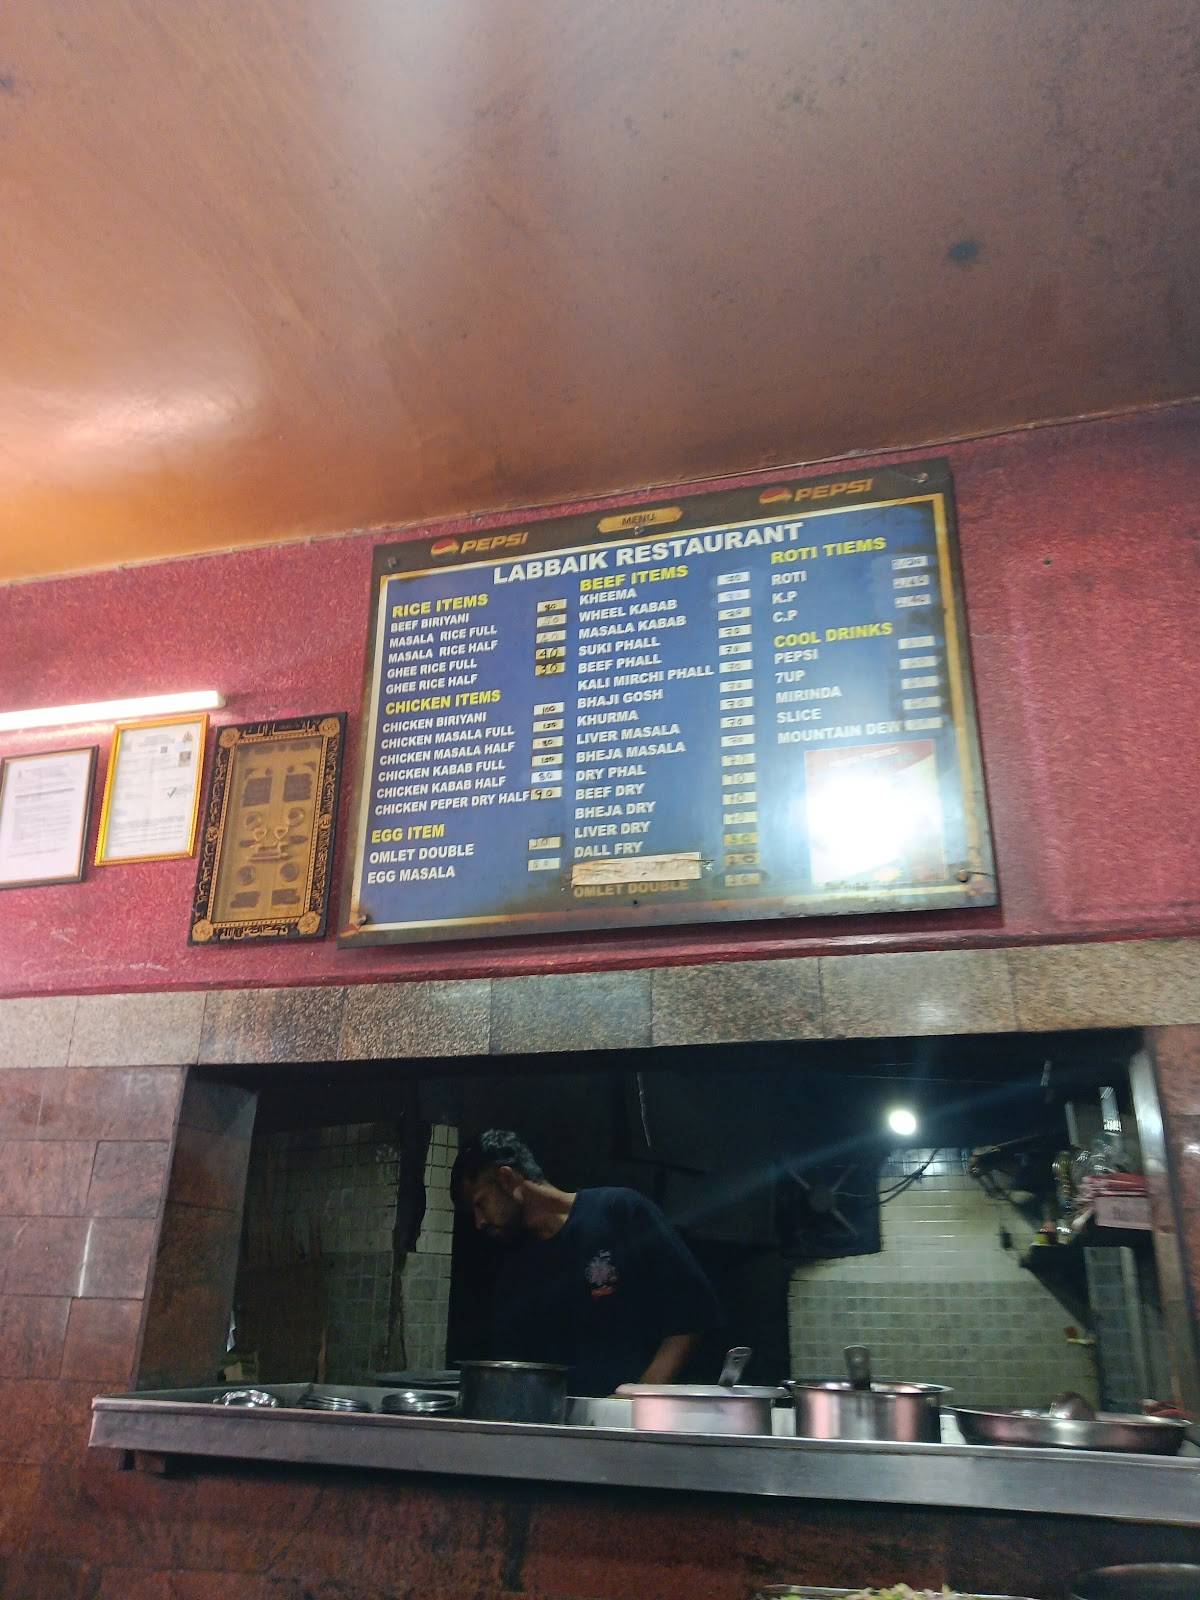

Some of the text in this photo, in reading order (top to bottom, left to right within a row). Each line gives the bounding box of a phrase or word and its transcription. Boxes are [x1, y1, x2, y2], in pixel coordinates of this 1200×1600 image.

[794, 478, 874, 502] PEPSI
[621, 514, 656, 526] MENU
[461, 532, 529, 553] PEPSI
[771, 537, 887, 565] ROTI TIEMS
[494, 522, 804, 584] LABBAIK RESTAURANT
[580, 566, 688, 591] BEEF ITEMS
[771, 572, 807, 585] ROTI
[392, 594, 488, 617] RICE ITEMS
[580, 588, 637, 605] KHEEMA
[580, 599, 678, 622] WHEEL KABAB
[390, 614, 469, 632] BEEF BIRIYANI
[579, 616, 687, 638] MASALA KABAB
[389, 625, 497, 647] MASALA RICE FULL
[774, 631, 820, 647] COOL
[826, 622, 893, 642] DRINKS
[388, 641, 498, 663] MASALA RICE HALF
[579, 637, 660, 657] SUKI PHALL
[774, 648, 818, 664] PEPSI
[387, 659, 477, 678] GHEE RICE FULL
[578, 655, 661, 673] BEEF PHALL
[386, 674, 478, 694] GHEE RICE HALF
[578, 665, 713, 691] KALI MIRCHI PHALL
[775, 669, 805, 683] 7UP
[385, 690, 501, 714] CHICKEN ITEMS
[578, 690, 663, 709] BHAJI GOSH
[776, 685, 842, 703] MIRINDA
[382, 712, 487, 732] CHICKEN BIRIYANI
[577, 710, 639, 726] KHURMA
[777, 708, 822, 723] SLICE
[381, 725, 514, 749] CHICKEN MASALA FULL
[576, 724, 680, 744] LIVER MASALA
[778, 723, 861, 743] MOUNTAIN
[379, 741, 516, 766] CHICKEN MASALA HALF
[576, 741, 686, 763] BHEJA MASALA
[378, 760, 505, 782] CHICKEN KABAB FULL
[576, 764, 646, 782] DRY PHAL
[377, 776, 506, 798] CHICKEN KABAB HALF
[575, 783, 645, 800] BEEF DRY
[375, 791, 530, 815] CHICKEN PEPER DRY HALF
[575, 802, 656, 819] BHEJA DRY
[371, 824, 445, 843] EGG ITEM
[575, 821, 651, 838] LIVER DRY
[370, 844, 474, 864] OMLET DOUBLE
[574, 841, 643, 858] DALL FRY
[368, 865, 455, 884] EGG MASALA
[574, 881, 688, 898] OMLET DOUBLE
